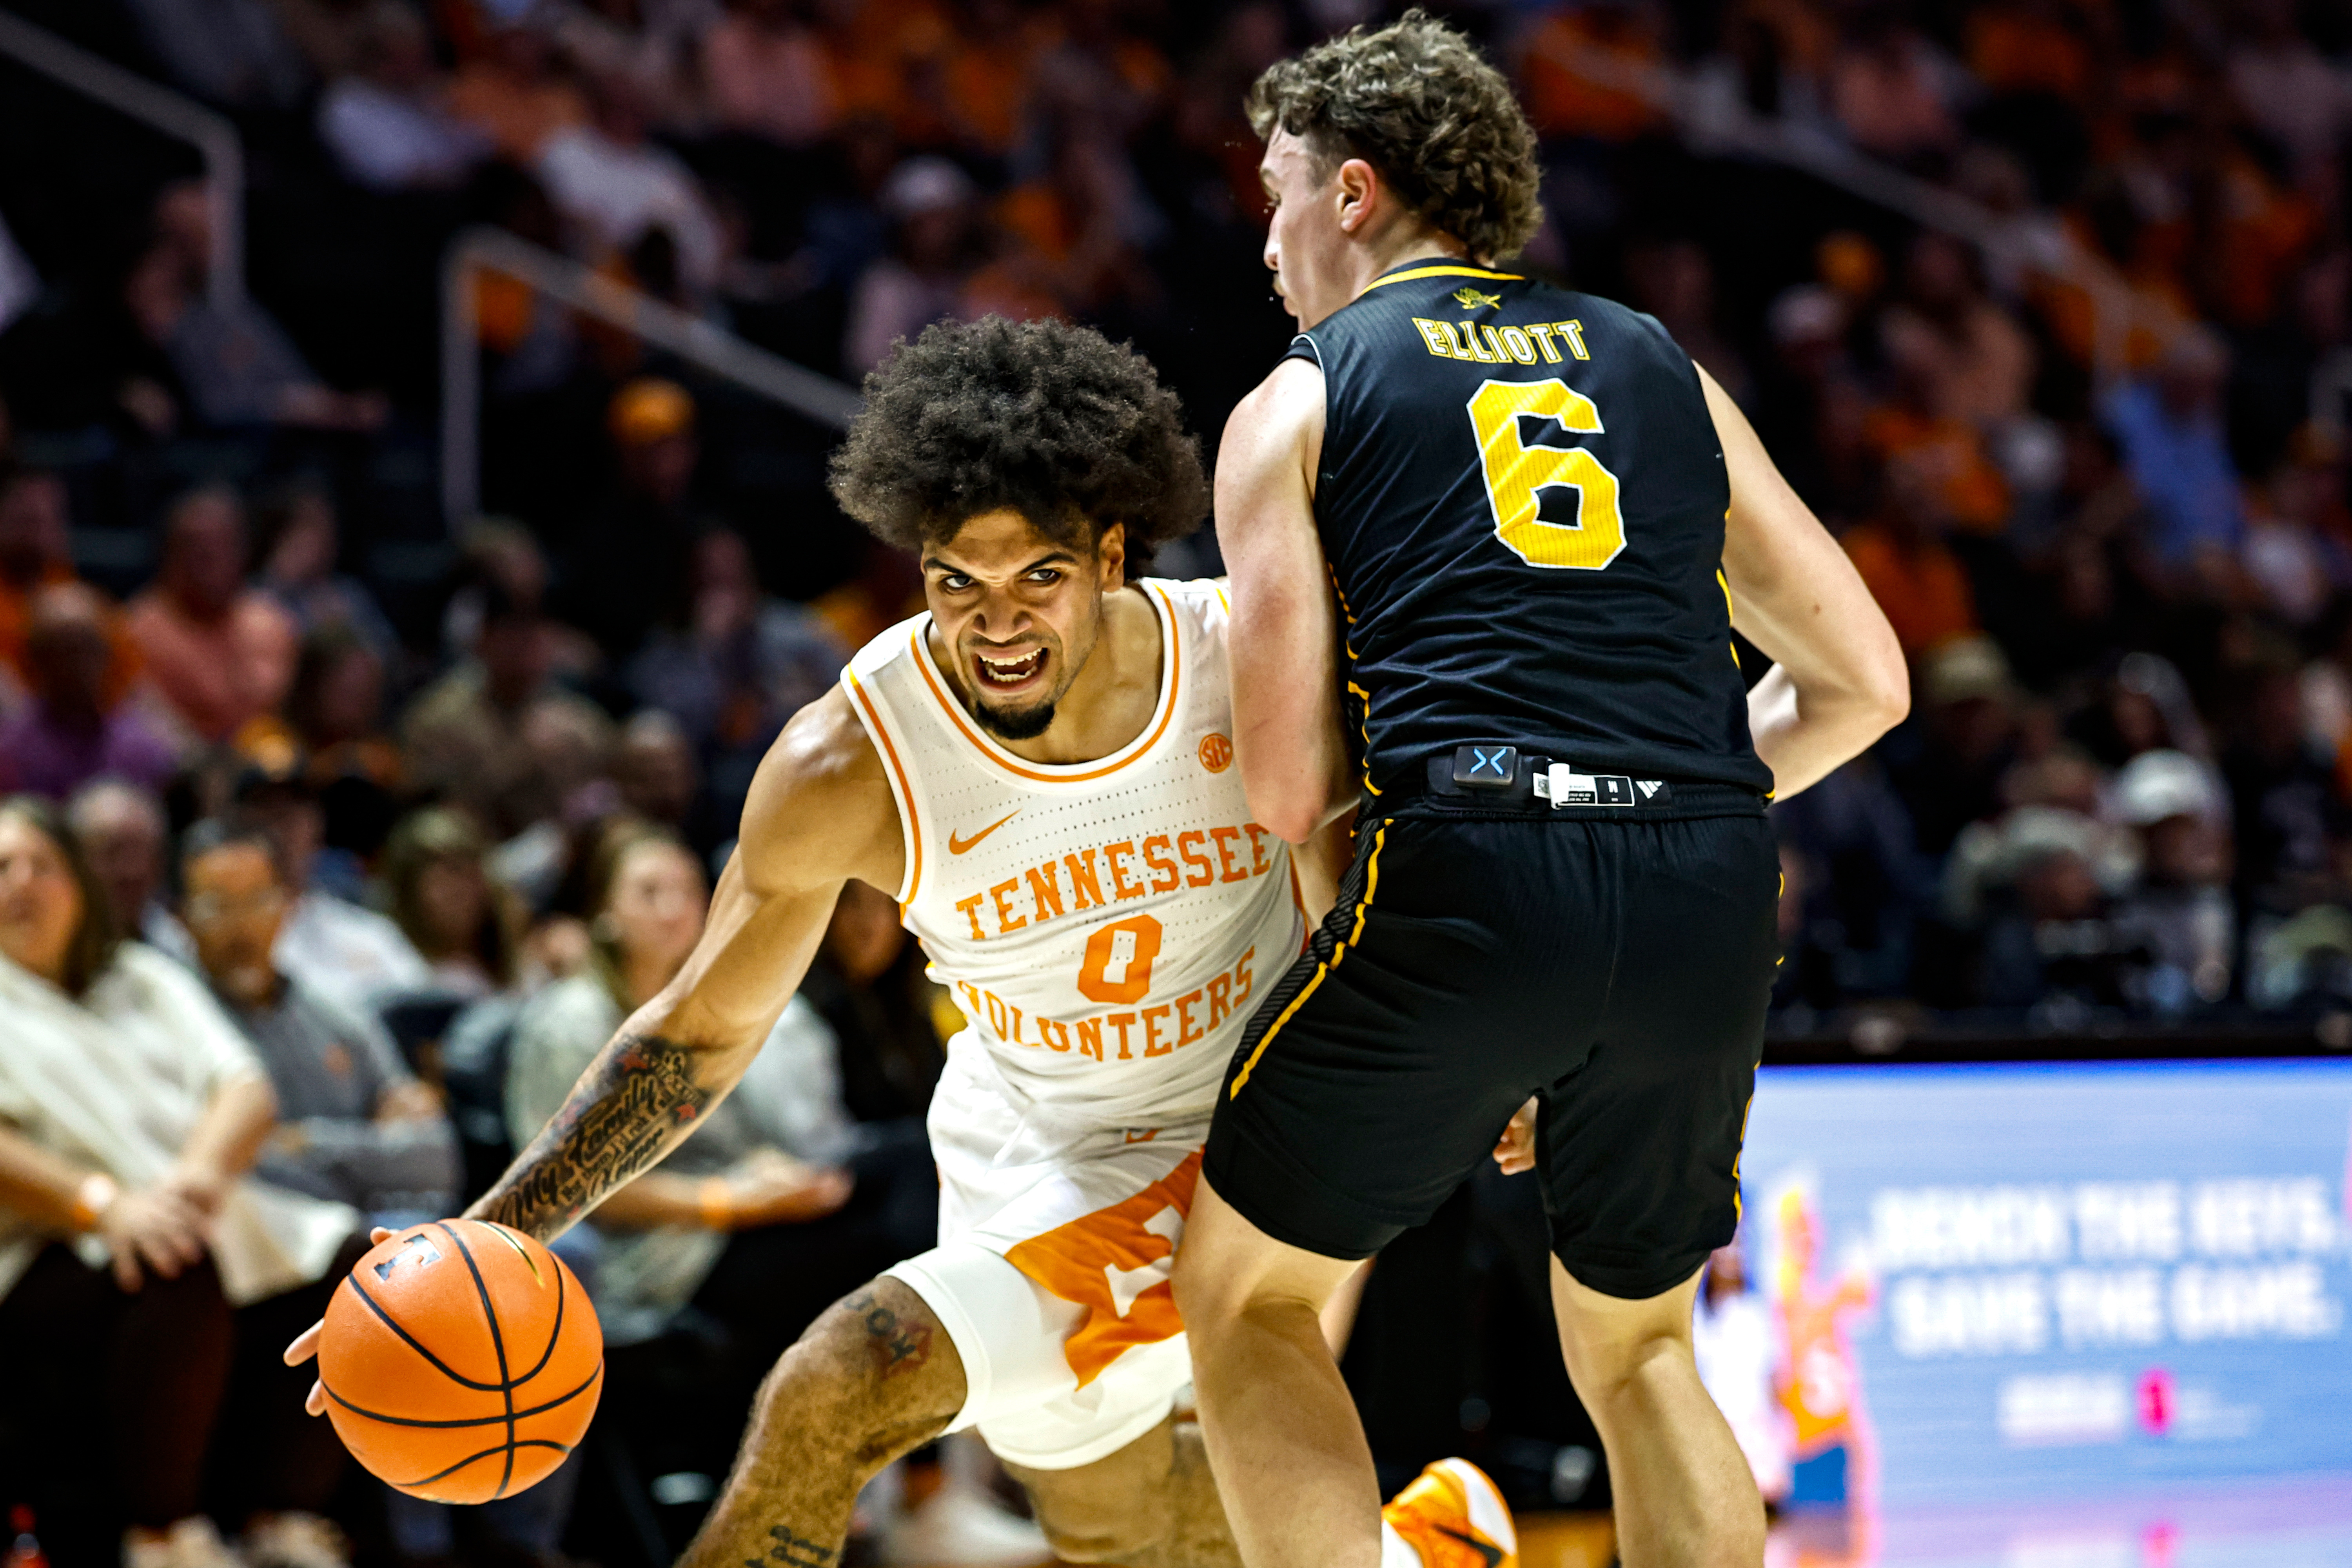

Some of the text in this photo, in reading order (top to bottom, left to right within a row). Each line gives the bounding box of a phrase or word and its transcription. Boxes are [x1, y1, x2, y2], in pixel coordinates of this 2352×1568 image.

[1412, 317, 1590, 365] ELLIOTT
[1466, 378, 1628, 571] 6
[1201, 735, 1231, 770] SEC
[956, 822, 1270, 940] TENNESSEE
[958, 946, 1254, 1062] VOLUNTEERS
[1078, 914, 1163, 1004] 0
[374, 1234, 441, 1281] T
